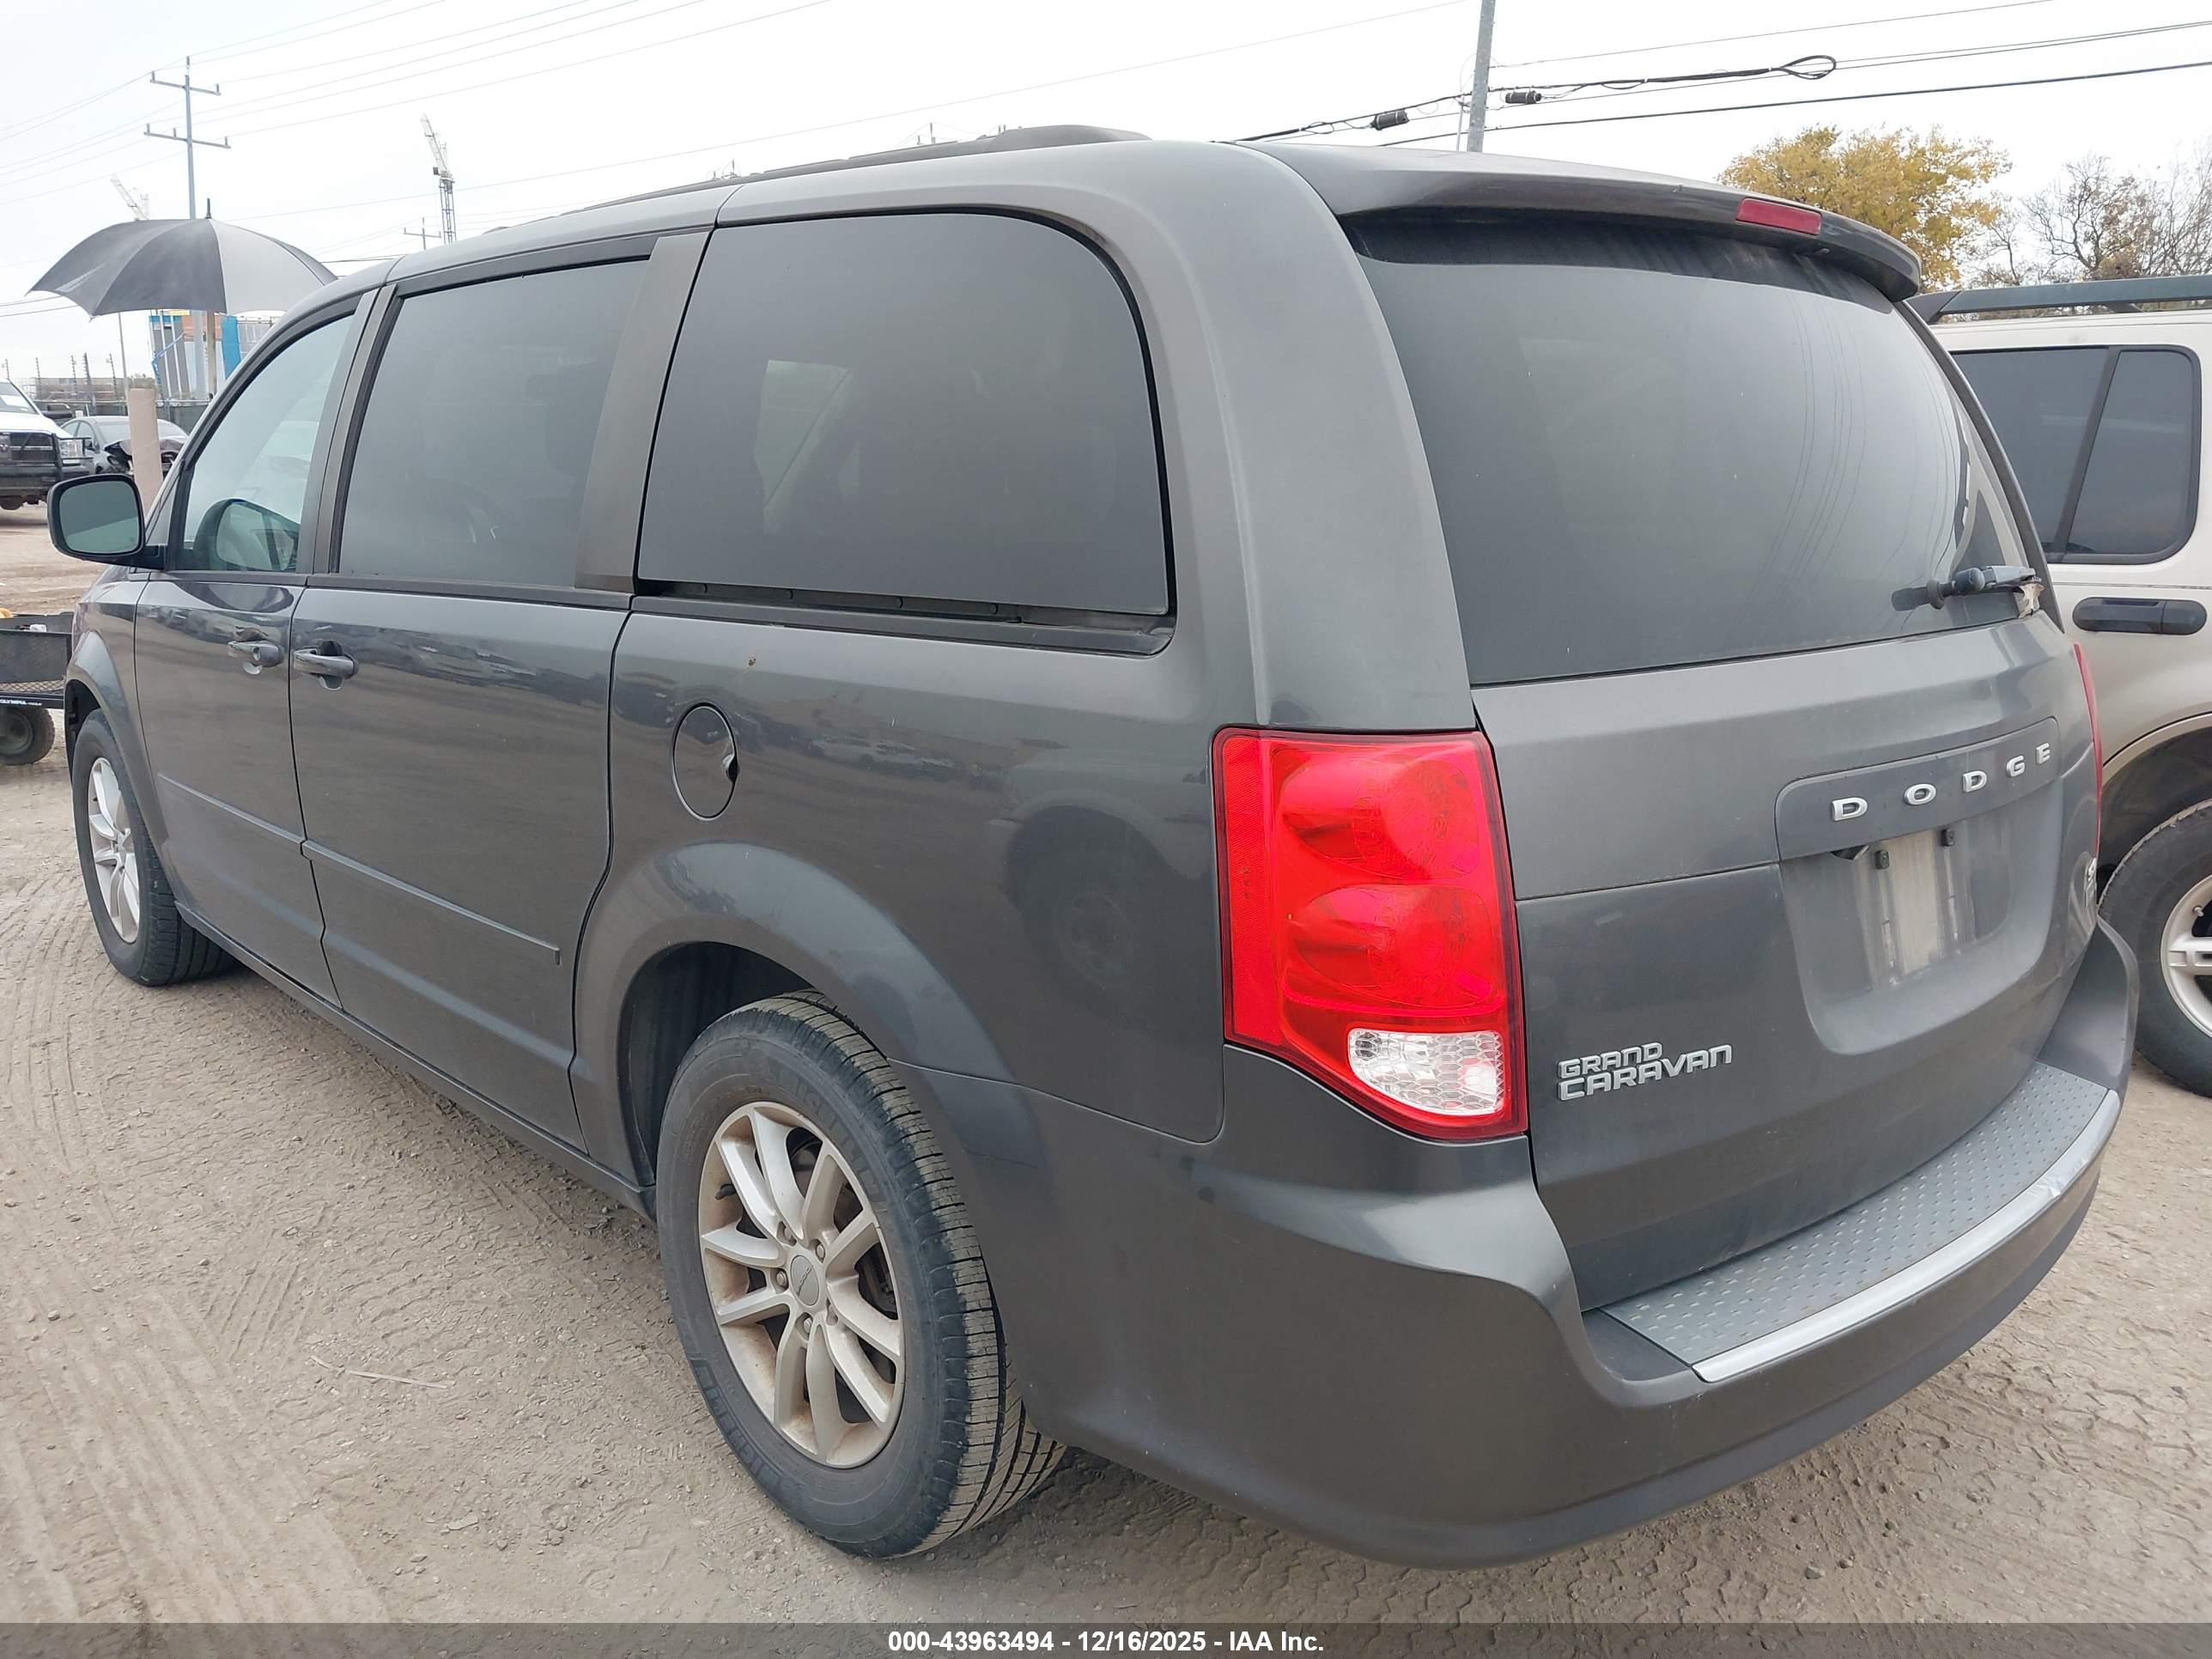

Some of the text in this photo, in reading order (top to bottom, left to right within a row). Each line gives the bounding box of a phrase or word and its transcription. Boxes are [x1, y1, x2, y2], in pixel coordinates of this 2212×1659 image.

[1831, 742, 2051, 822] DODGE
[1558, 1042, 1662, 1079] GRAND
[1558, 1044, 1732, 1101] CARAVAN
